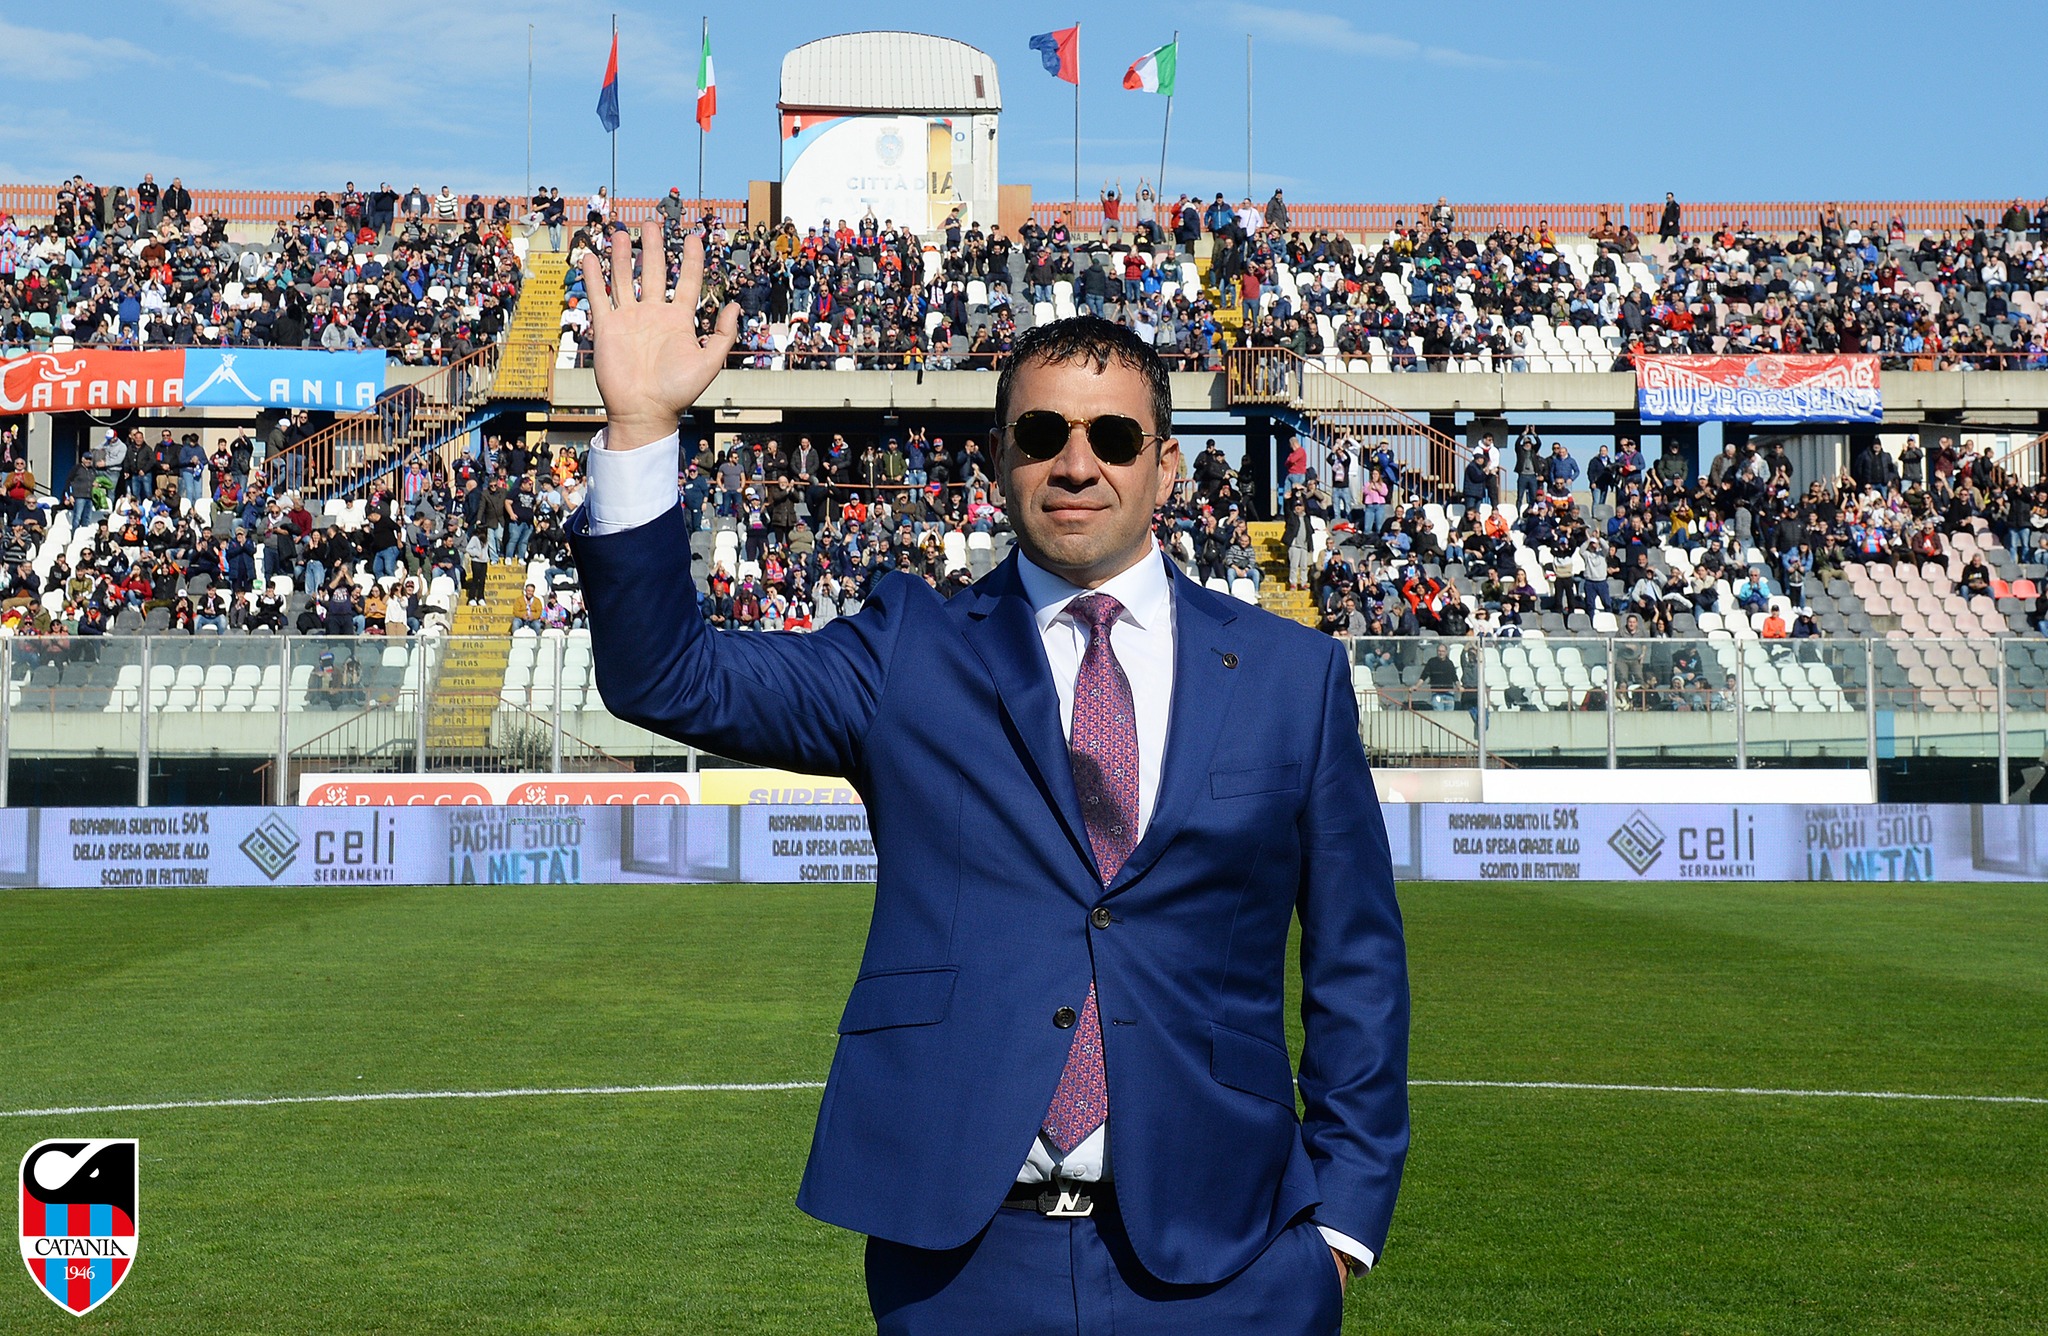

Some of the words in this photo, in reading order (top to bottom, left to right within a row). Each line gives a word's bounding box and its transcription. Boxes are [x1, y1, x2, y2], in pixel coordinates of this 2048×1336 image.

[0, 354, 184, 411] CATANIA
[70, 818, 127, 835] RISPARMIA
[129, 817, 167, 835] SUBITO
[168, 818, 179, 835] IL
[181, 811, 209, 834] 50%
[769, 814, 823, 832] RISPARMIA
[825, 814, 861, 831] SUBITO
[1449, 814, 1502, 830] RISPARMIA
[1503, 813, 1539, 830] SUBITO
[1540, 814, 1551, 830] IL
[1553, 808, 1579, 830] 50%
[313, 811, 395, 865] celi
[449, 822, 511, 852] PAGHI
[1678, 808, 1755, 860] celi
[1806, 820, 1865, 849] PAGHI
[1877, 815, 1932, 847] SOLO
[73, 843, 106, 860] DELLA
[108, 843, 142, 860] SPESA
[143, 843, 181, 860] GRAZIE
[183, 843, 209, 860] ALLO
[773, 840, 803, 857] DELLA
[806, 840, 837, 857] SPESA
[1453, 838, 1483, 854] DELLA
[1486, 838, 1517, 854] SPESA
[1519, 838, 1553, 854] GRAZIE
[1555, 838, 1580, 854] ALLO
[101, 868, 143, 885] SCONTO
[146, 868, 158, 884] IN
[313, 868, 394, 882] SERRAMENTI
[799, 864, 840, 880] SCONTO
[842, 864, 853, 880] IN
[1480, 862, 1519, 879] SCONTO
[1521, 862, 1532, 878] IN
[1679, 864, 1755, 877] SERRAMENTI
